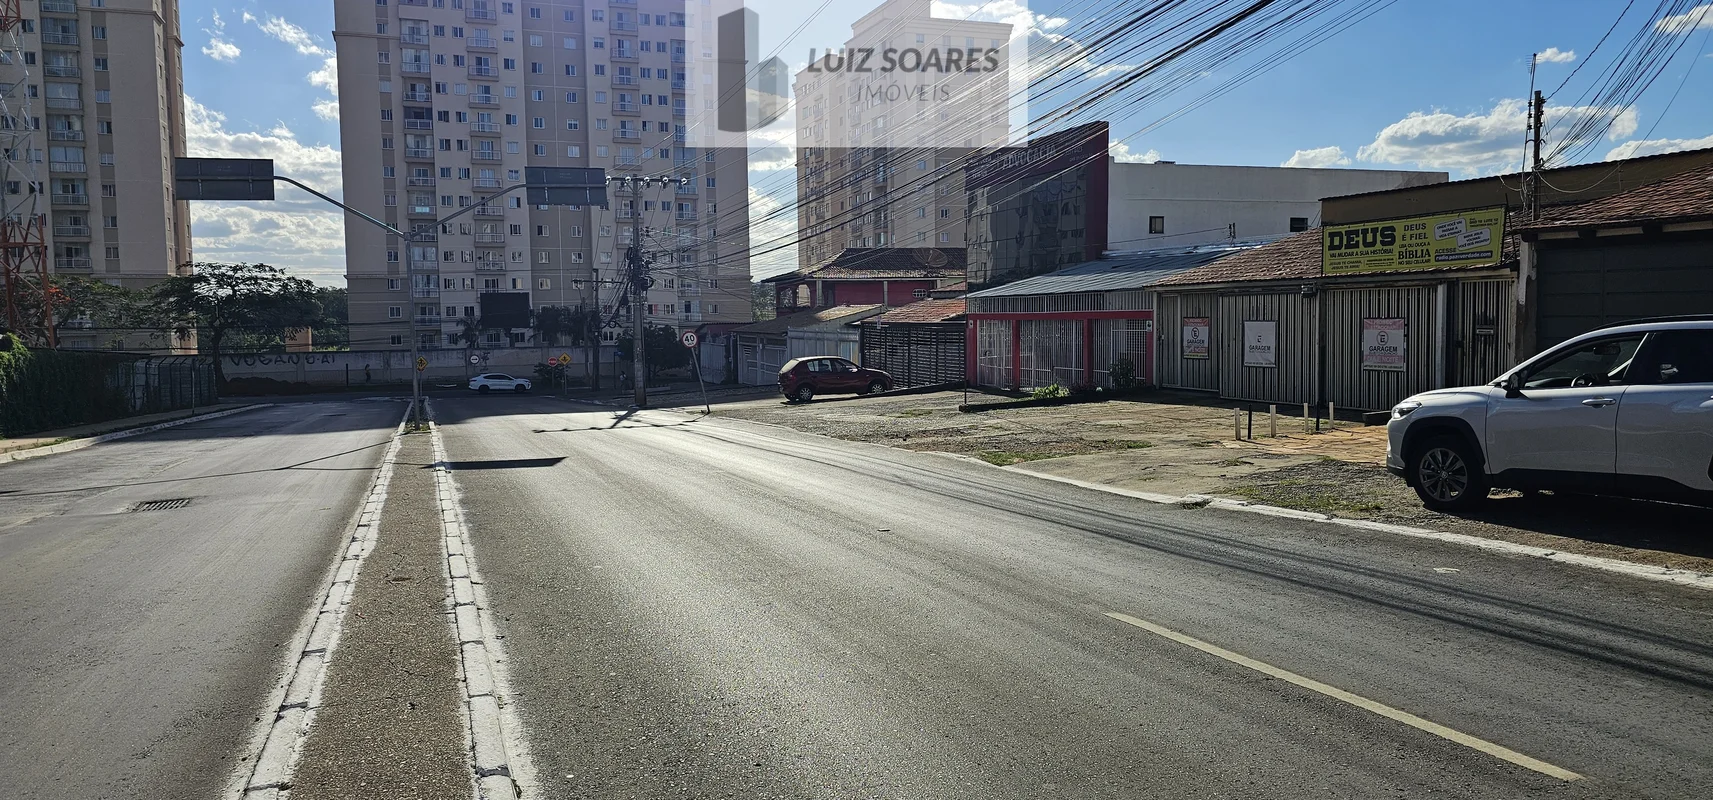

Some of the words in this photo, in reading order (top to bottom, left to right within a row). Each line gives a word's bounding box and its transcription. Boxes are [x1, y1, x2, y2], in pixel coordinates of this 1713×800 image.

[1404, 223, 1427, 231] DEUS
[1328, 226, 1396, 251] DEUS
[1402, 233, 1407, 241] É
[1410, 233, 1428, 241] FIEL
[1398, 247, 1431, 260] BÍBLIA
[684, 334, 695, 342] 40
